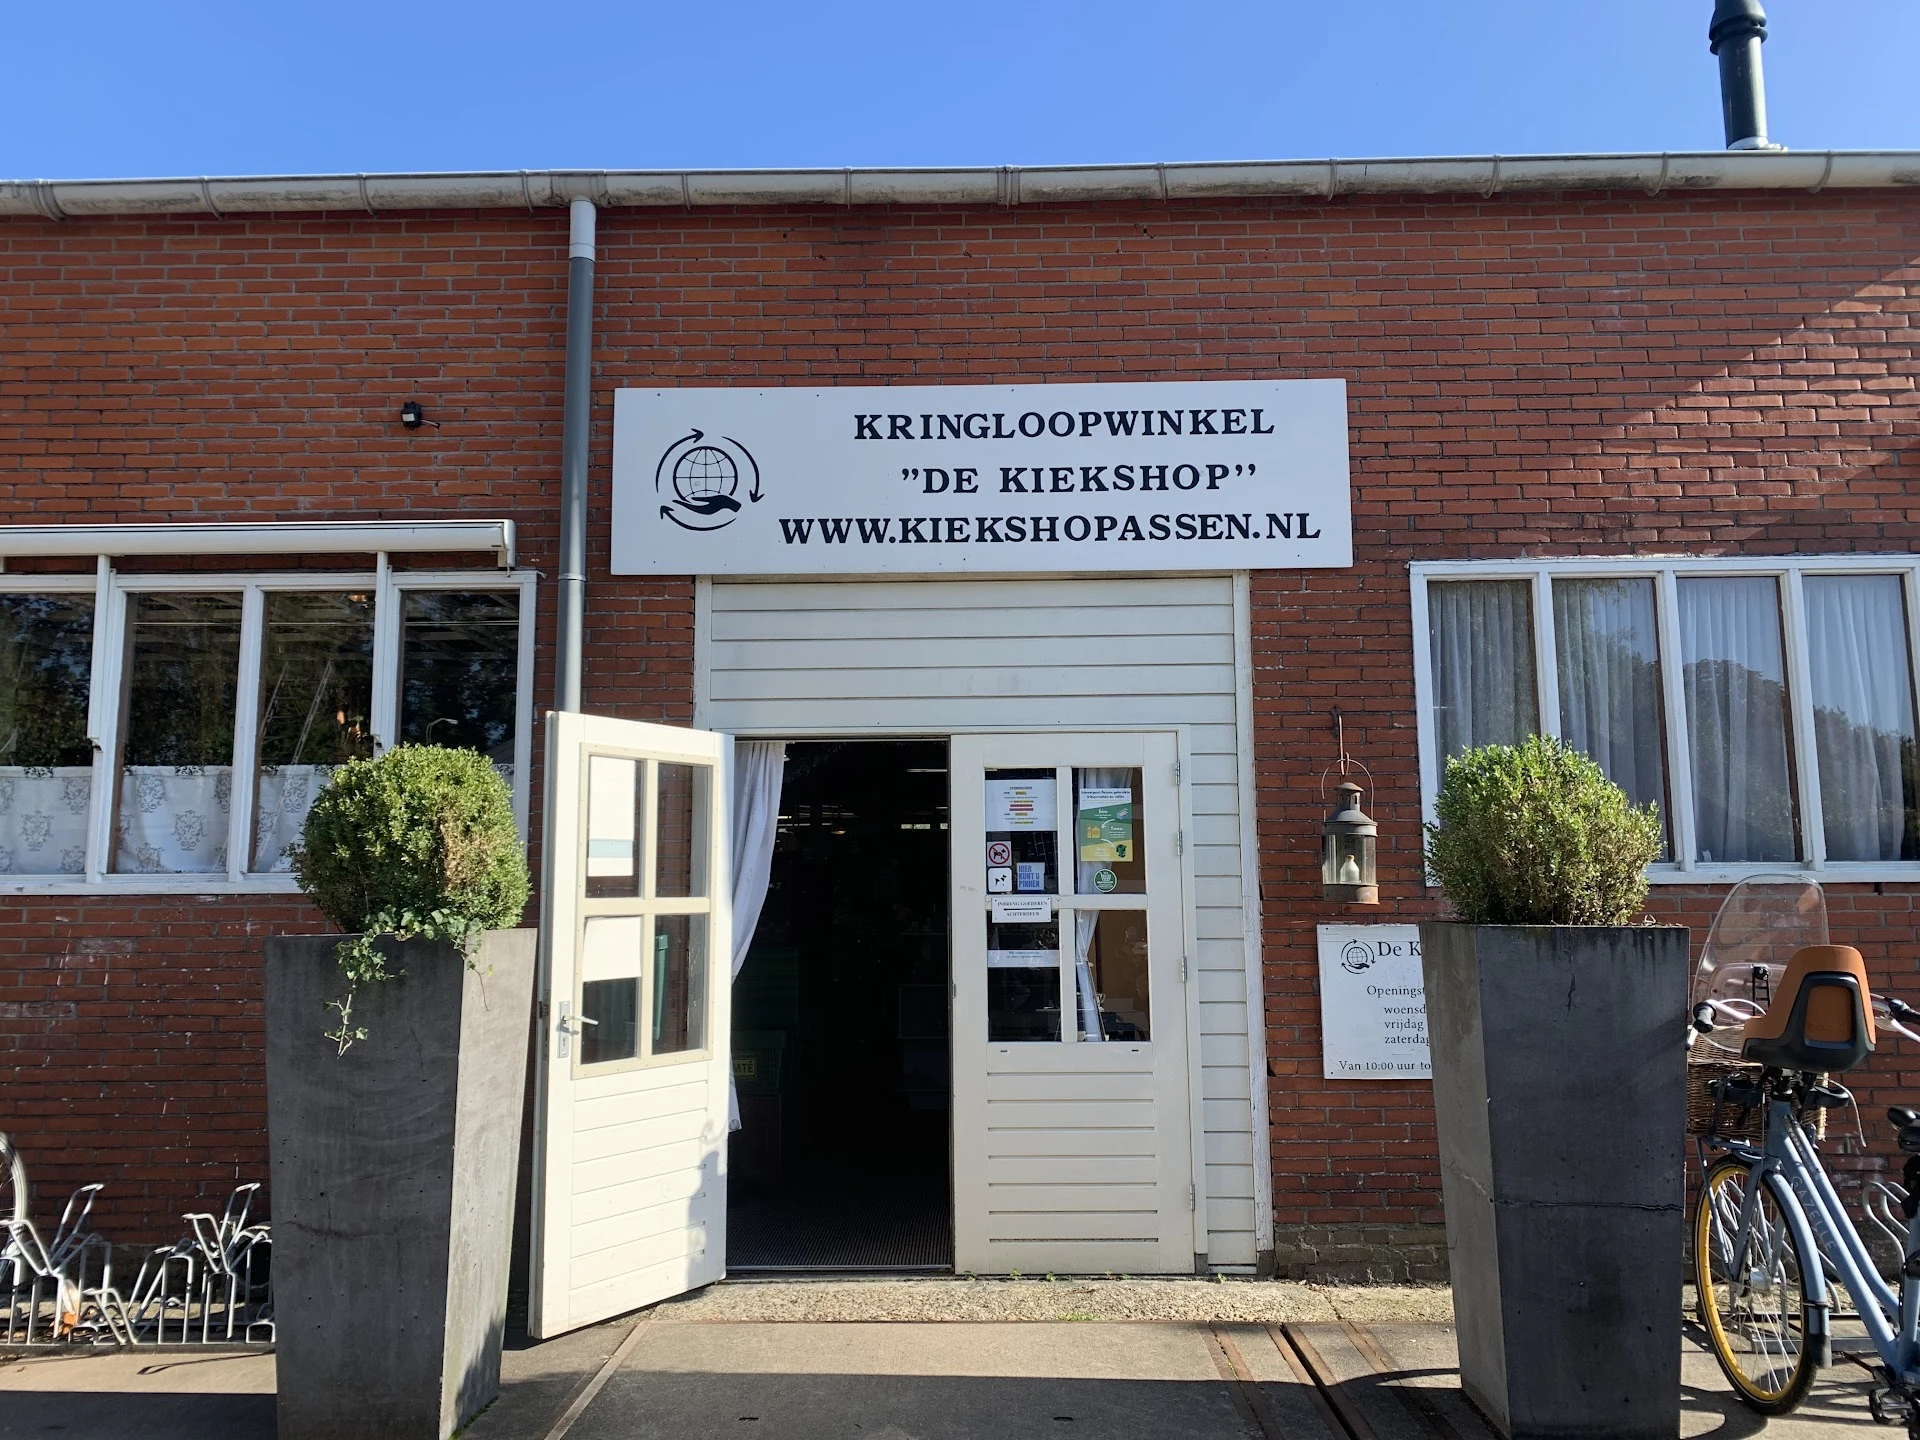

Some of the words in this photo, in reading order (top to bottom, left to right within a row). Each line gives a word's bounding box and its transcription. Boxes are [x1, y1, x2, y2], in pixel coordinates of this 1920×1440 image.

[854, 408, 1275, 440] KRINGLOOPWINKEL
[781, 512, 1322, 545] WWW.KIEKSHOPASSEN.NL
[1018, 865, 1032, 873] HIER
[1018, 880, 1040, 888] PINNEN
[1377, 941, 1402, 957] De
[1384, 1018, 1424, 1032] vrijdag
[1339, 1060, 1361, 1071] Van
[1365, 1061, 1394, 1071] 10:00
[1396, 1062, 1415, 1071] uur
[1792, 1176, 1837, 1252] GAZELLE
